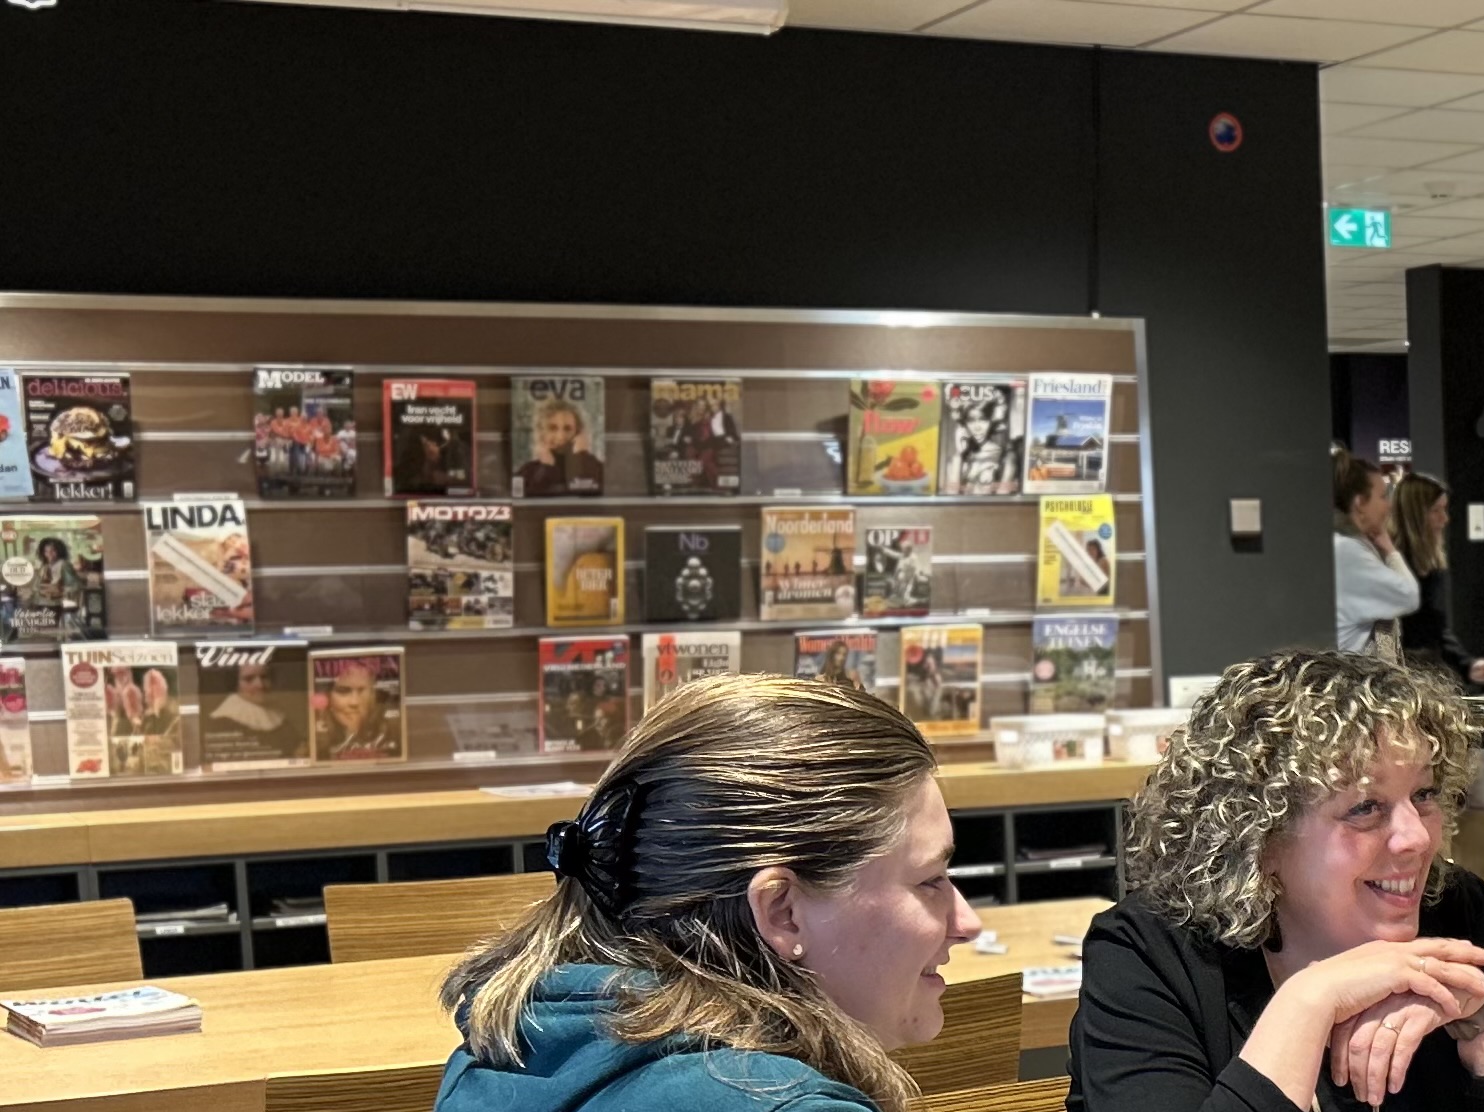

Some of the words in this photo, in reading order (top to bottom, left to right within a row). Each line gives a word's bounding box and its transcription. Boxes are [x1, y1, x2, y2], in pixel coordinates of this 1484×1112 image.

[391, 383, 418, 400] EW
[530, 378, 585, 401] eva
[1033, 380, 1101, 395] Friesland
[1379, 440, 1412, 454] RES
[55, 483, 113, 500] lekker!
[766, 514, 854, 534] Noorderland
